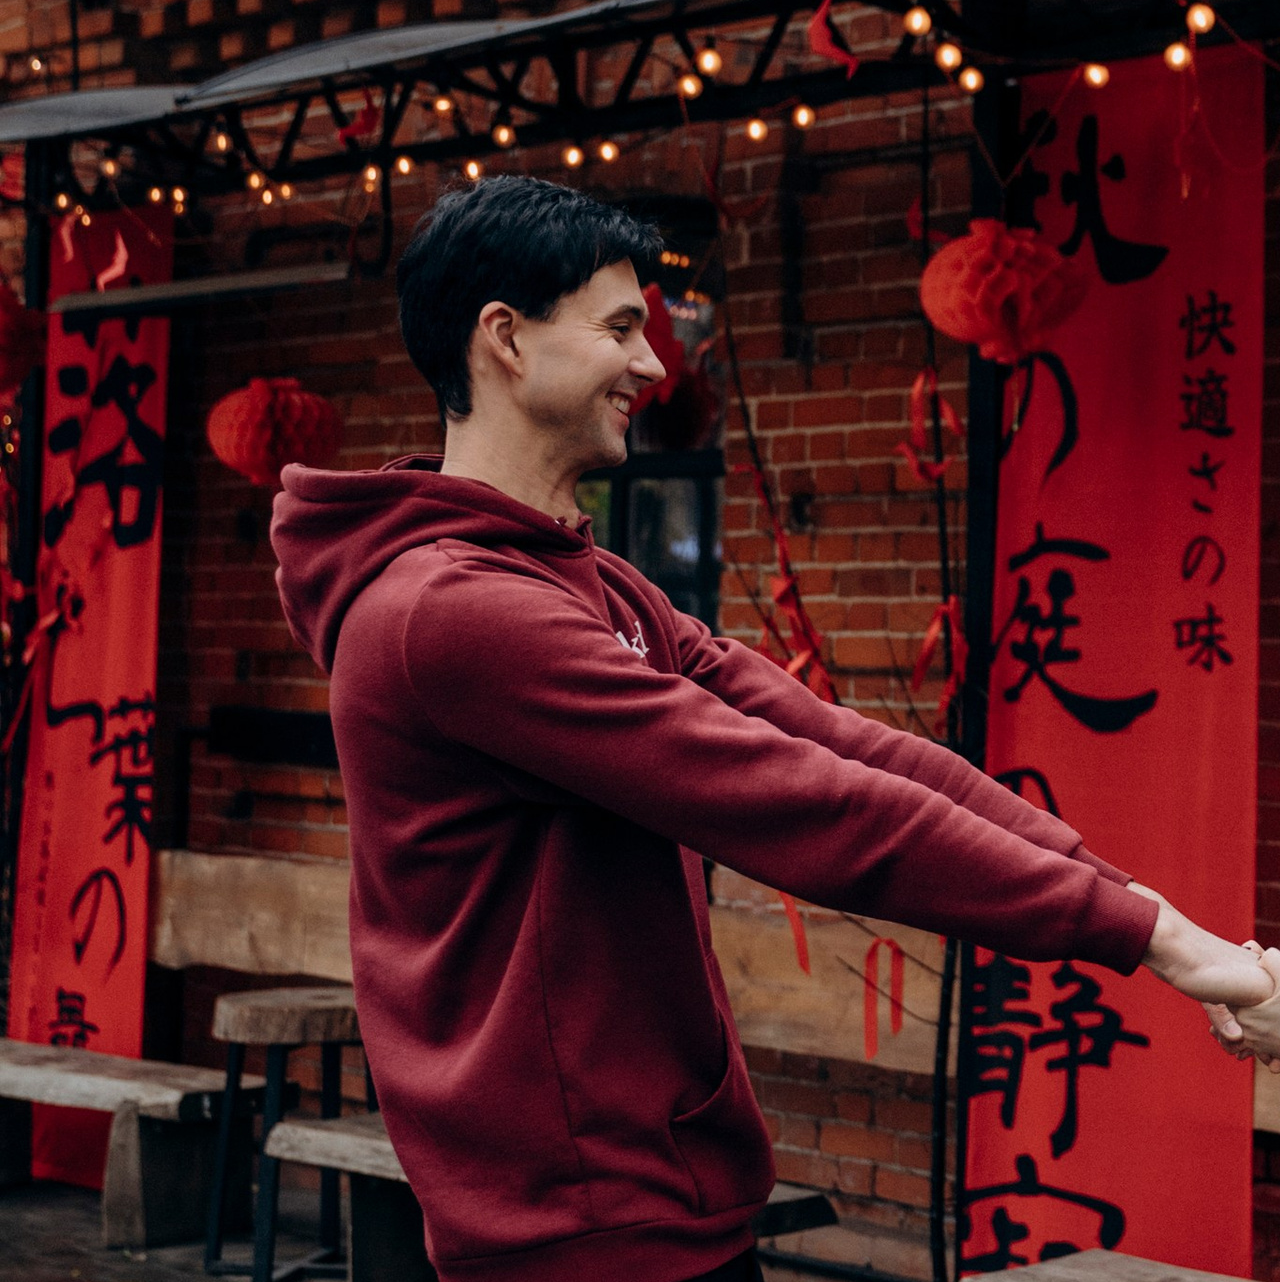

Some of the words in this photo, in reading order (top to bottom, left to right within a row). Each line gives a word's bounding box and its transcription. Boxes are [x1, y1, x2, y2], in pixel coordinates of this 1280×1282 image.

[1173, 288, 1238, 673] 快適さの味
